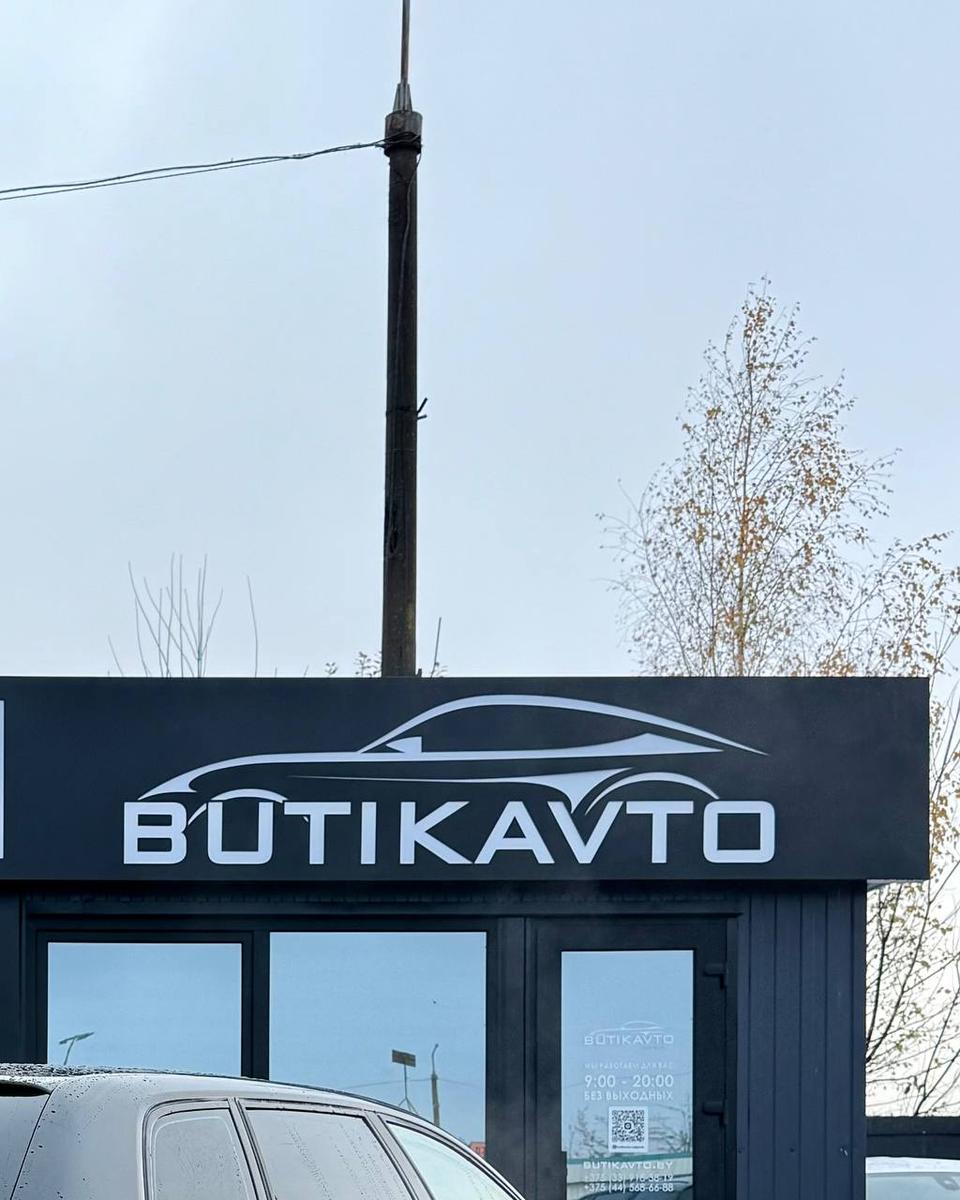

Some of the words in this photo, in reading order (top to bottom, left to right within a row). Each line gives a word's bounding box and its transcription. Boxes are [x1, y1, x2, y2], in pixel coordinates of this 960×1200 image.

[123, 799, 776, 865] BUTIKAVTO
[584, 1034, 674, 1045] BUTIKAVTO
[584, 1074, 616, 1088] 9:00
[632, 1074, 674, 1088] 20:00
[584, 1090, 602, 1101] БЕЗ
[606, 1090, 673, 1101] ВЫХОДНЫХ
[583, 1161, 673, 1170] BUTIKAVTO.BY
[609, 1182, 626, 1194] (44)
